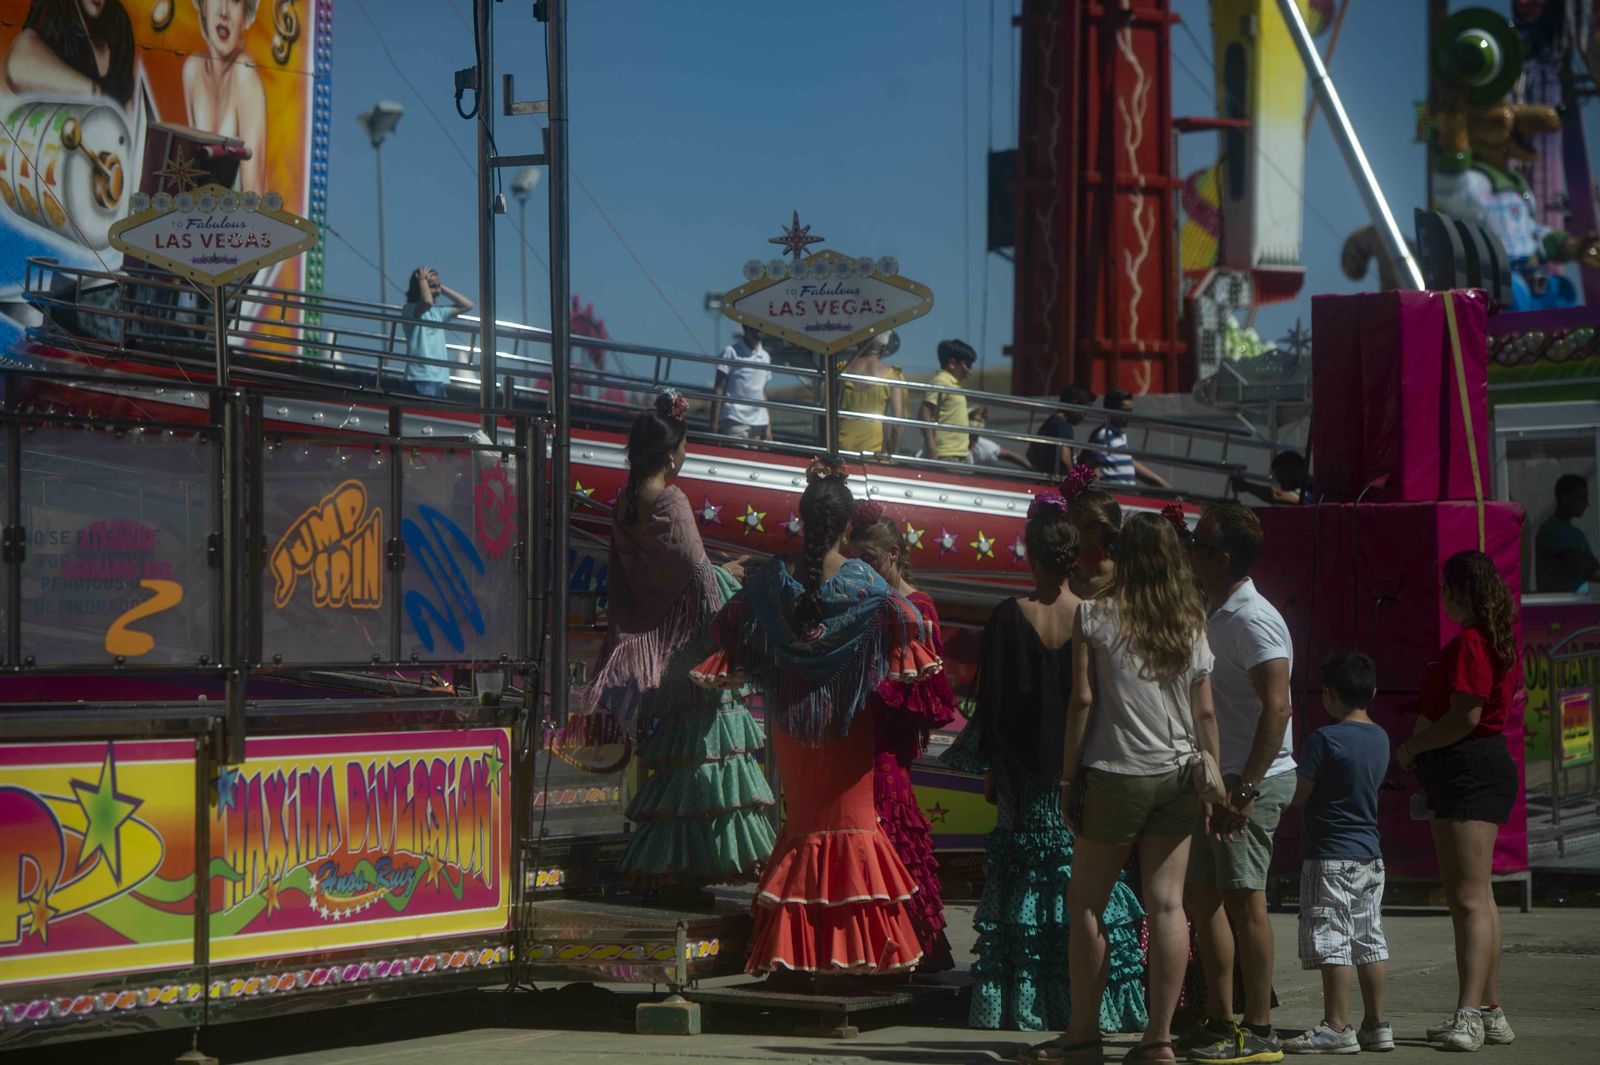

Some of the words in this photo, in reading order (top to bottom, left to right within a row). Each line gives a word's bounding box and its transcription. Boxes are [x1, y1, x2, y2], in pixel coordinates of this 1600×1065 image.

[171, 220, 183, 228] TO
[185, 215, 247, 230] Fabulous
[155, 233, 192, 249] LAS
[200, 232, 272, 249] VEGAS
[785, 288, 798, 296] TO
[799, 281, 861, 297] Fabulous
[768, 300, 807, 317] LAS
[813, 298, 886, 316] VEGAS
[49, 530, 70, 545] SE
[272, 484, 365, 604] JUMP
[314, 512, 381, 604] SPIN
